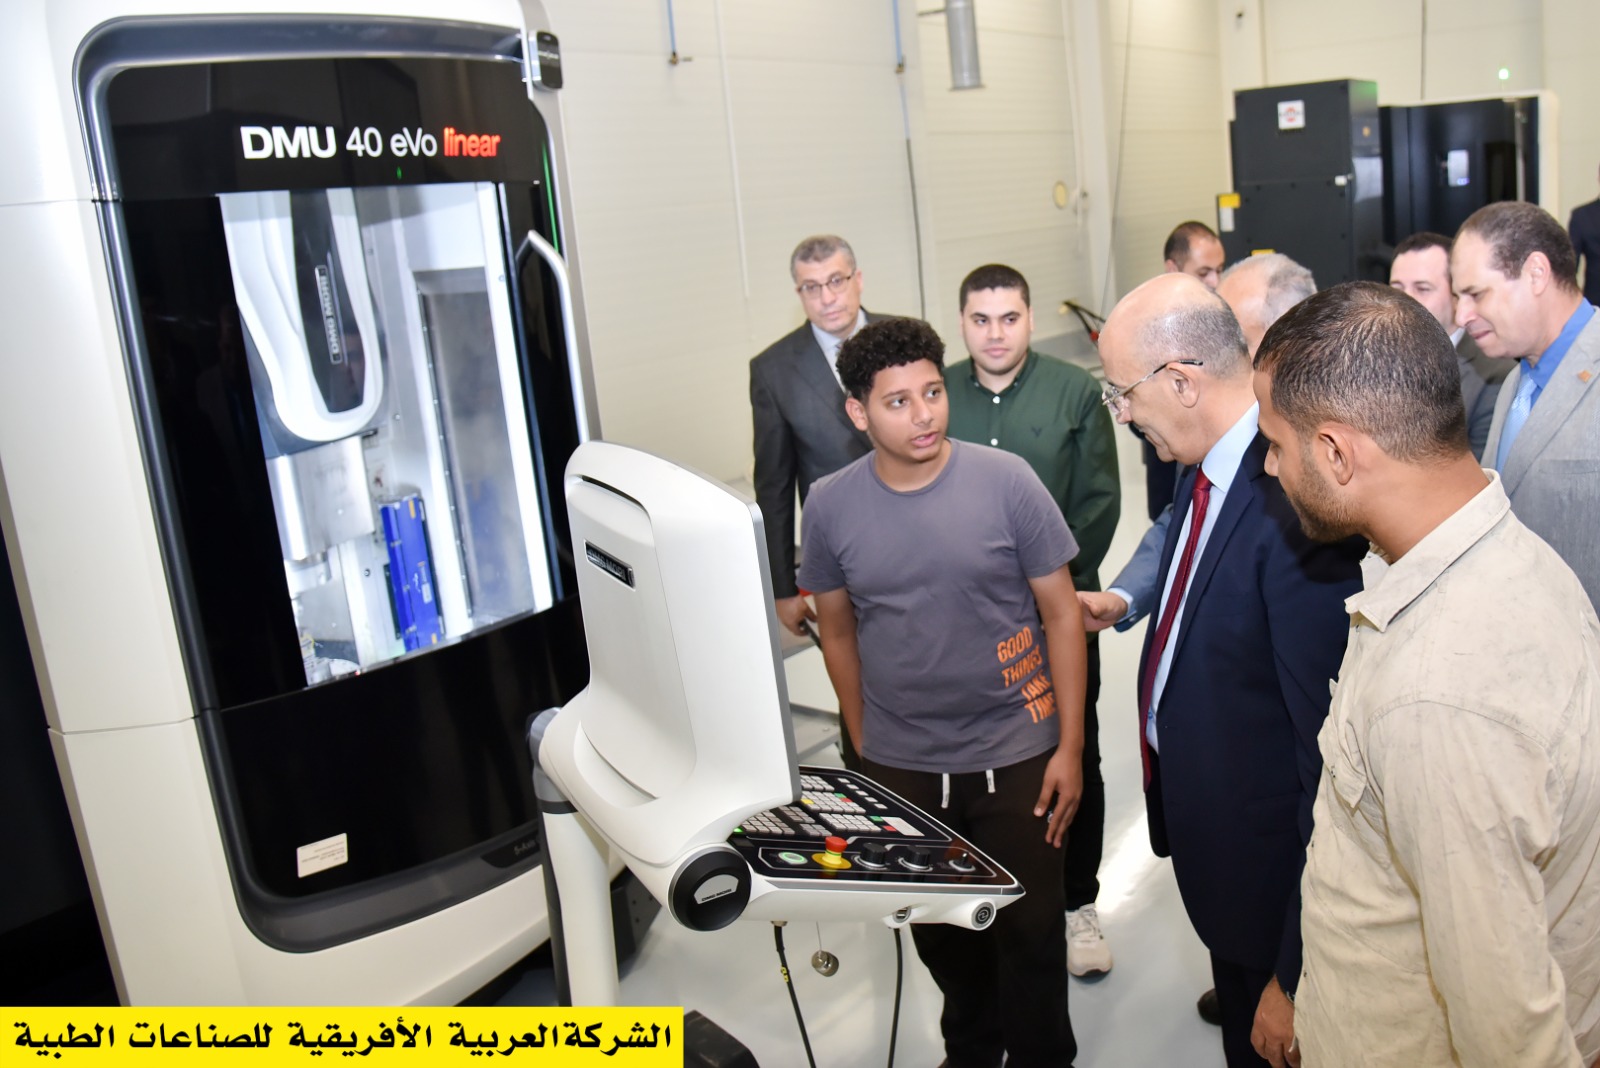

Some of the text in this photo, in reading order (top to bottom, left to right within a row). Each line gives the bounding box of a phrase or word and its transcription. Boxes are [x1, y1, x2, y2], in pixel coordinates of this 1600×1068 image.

[240, 126, 501, 159] DMU 40 eVo linear
[997, 626, 1033, 663] GOOD
[1001, 644, 1043, 688] THINGS
[1024, 691, 1055, 724] TIME
